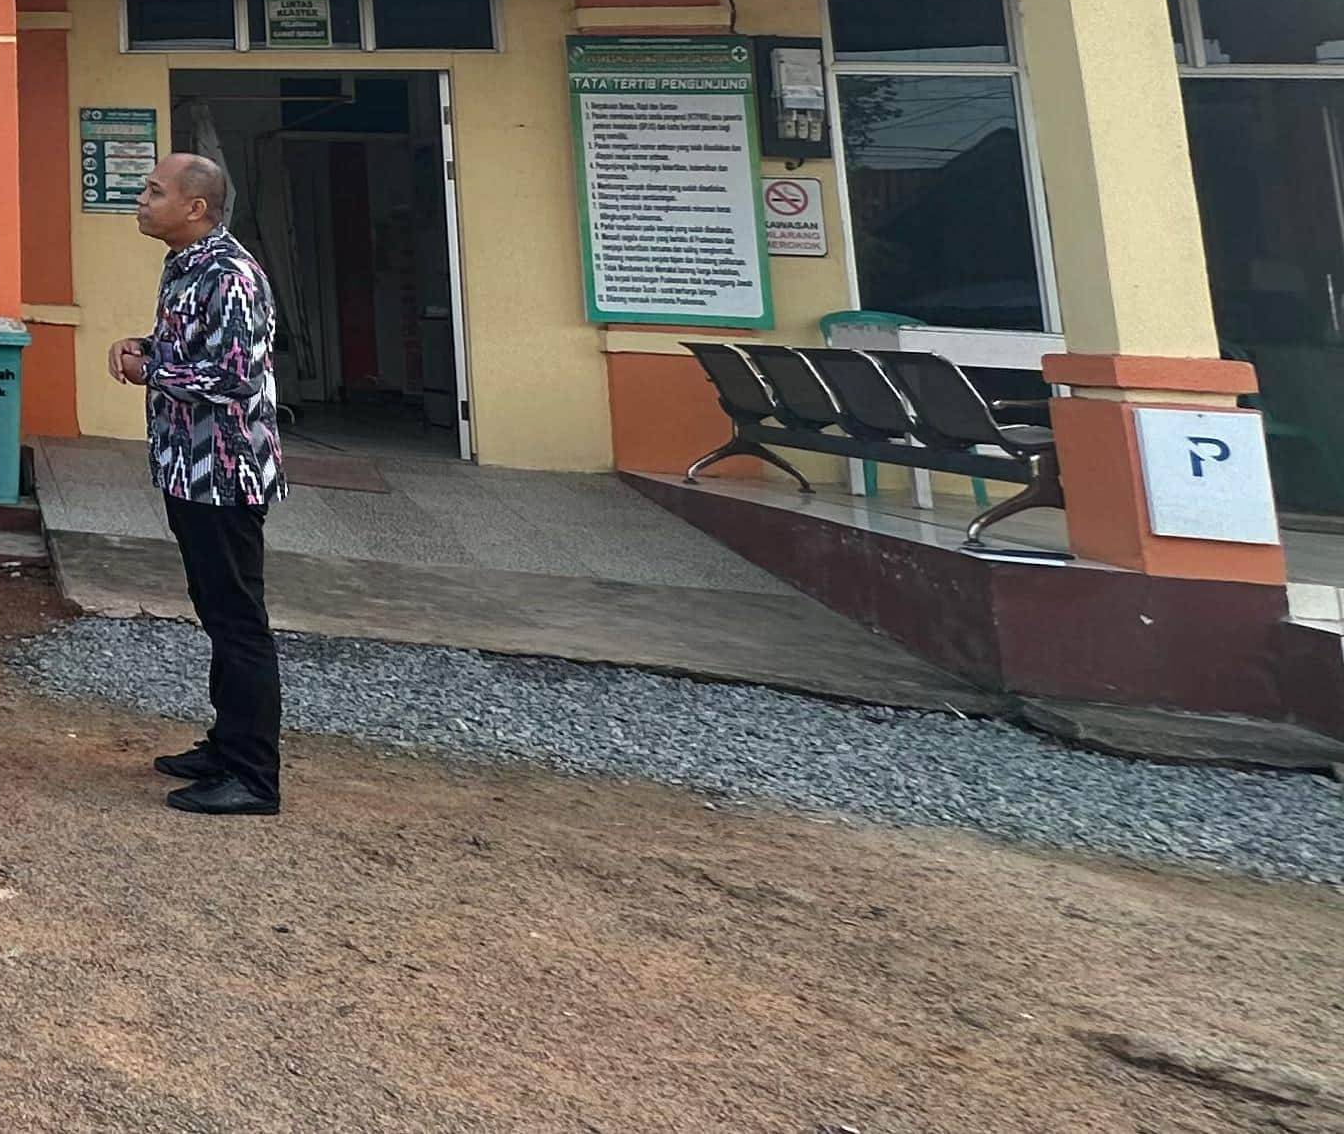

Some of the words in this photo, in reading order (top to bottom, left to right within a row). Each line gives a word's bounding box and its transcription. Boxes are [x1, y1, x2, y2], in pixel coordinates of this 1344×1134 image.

[573, 78, 608, 90] TATA
[612, 78, 656, 90] TERTIB
[661, 78, 748, 90] PENGUNJUNG
[1187, 436, 1231, 477] P
